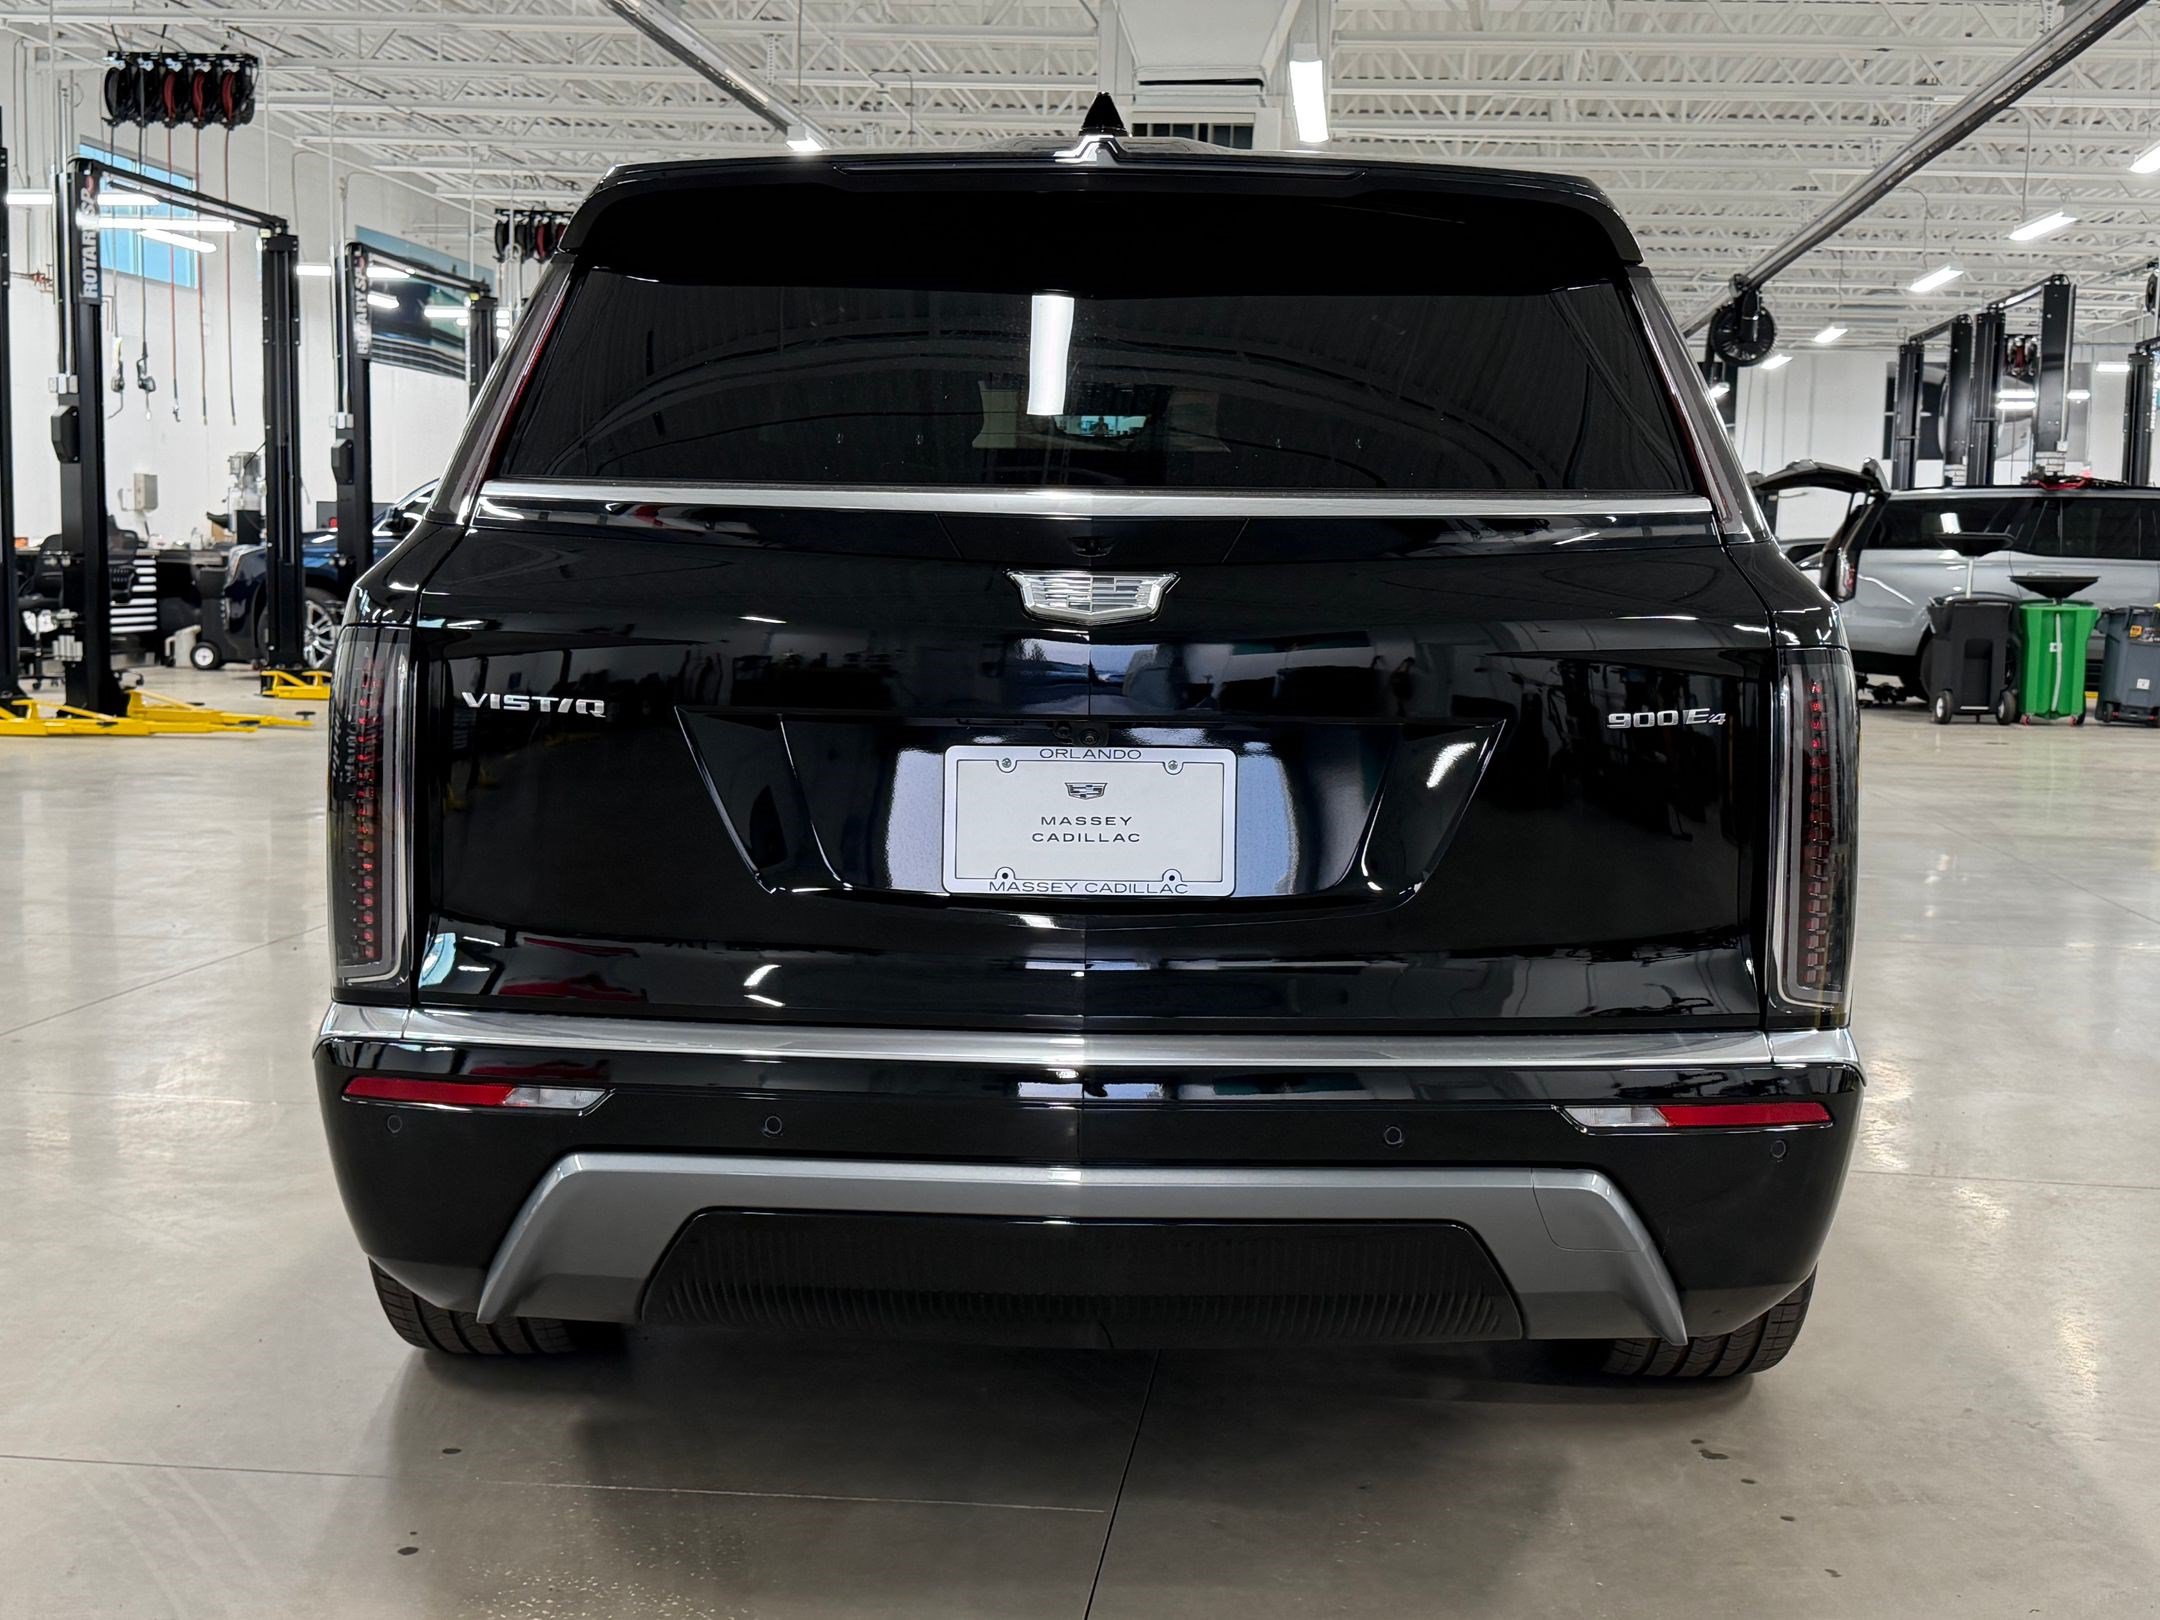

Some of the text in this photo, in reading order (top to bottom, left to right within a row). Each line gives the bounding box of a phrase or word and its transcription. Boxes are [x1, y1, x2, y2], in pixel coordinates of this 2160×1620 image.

[82, 219, 99, 298] ROTAR
[1039, 748, 1142, 760] ORLANDO
[1040, 816, 1132, 826] MASSEY
[1031, 832, 1141, 843] CADILLAC
[988, 881, 1189, 895] MASSEY CADILLAC
